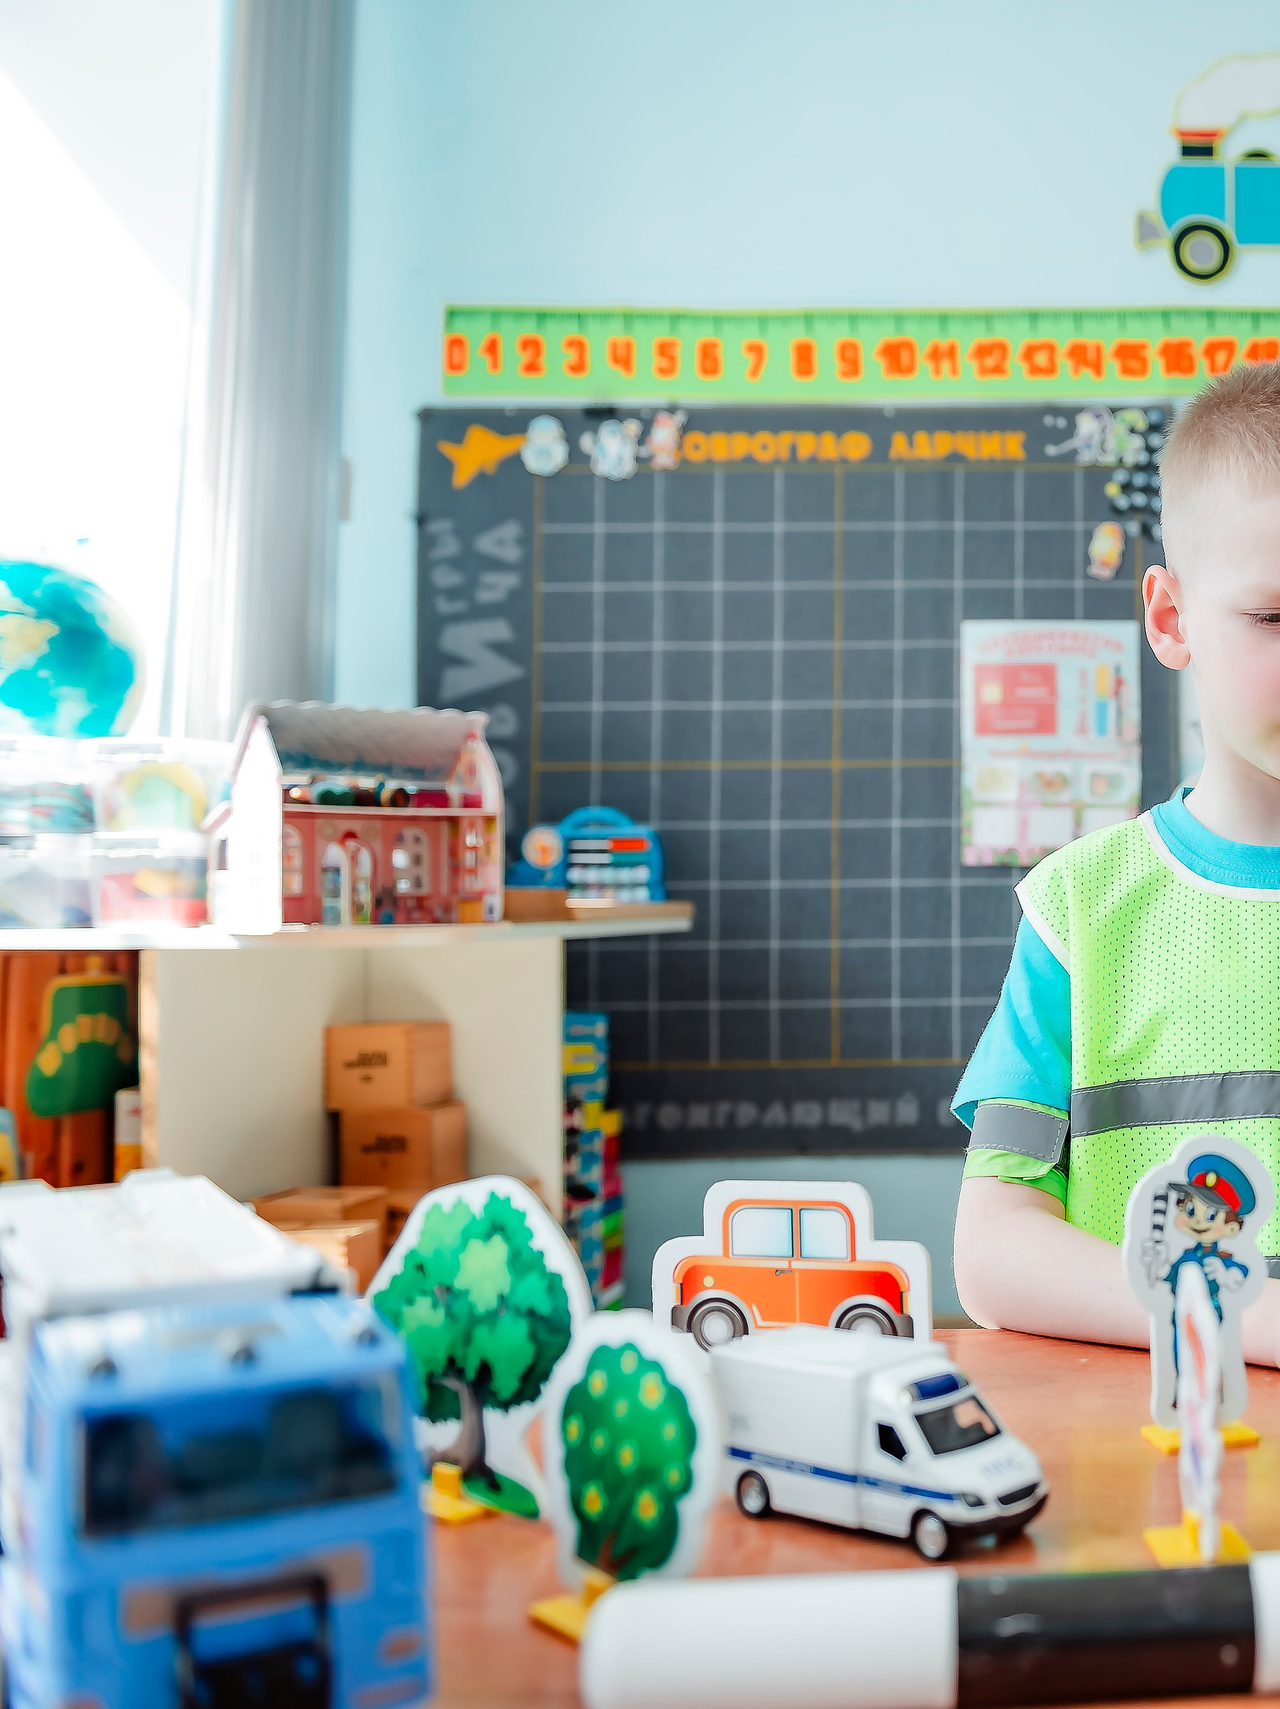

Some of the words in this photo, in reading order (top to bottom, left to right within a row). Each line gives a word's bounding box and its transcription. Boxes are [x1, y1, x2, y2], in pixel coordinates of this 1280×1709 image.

[444, 333, 469, 375] 0
[480, 332, 502, 373] 1
[517, 333, 545, 376] 2
[562, 335, 589, 376] 3
[608, 337, 635, 375] 4
[654, 338, 679, 378] 5
[697, 338, 722, 379] 6
[745, 340, 767, 379] 7
[793, 339, 817, 380] 8
[837, 338, 864, 379] 9
[876, 337, 919, 378] 10
[924, 340, 960, 378] 11
[968, 338, 1011, 378] 12
[1018, 339, 1060, 378] 13
[1063, 339, 1107, 380] 14
[1108, 338, 1152, 379] 15
[1156, 336, 1199, 378] 16
[1198, 335, 1240, 377] 17
[676, 430, 872, 463] ОВРОГРАФ
[620, 1091, 920, 1132] ГОИГРАЮЩИЙ
